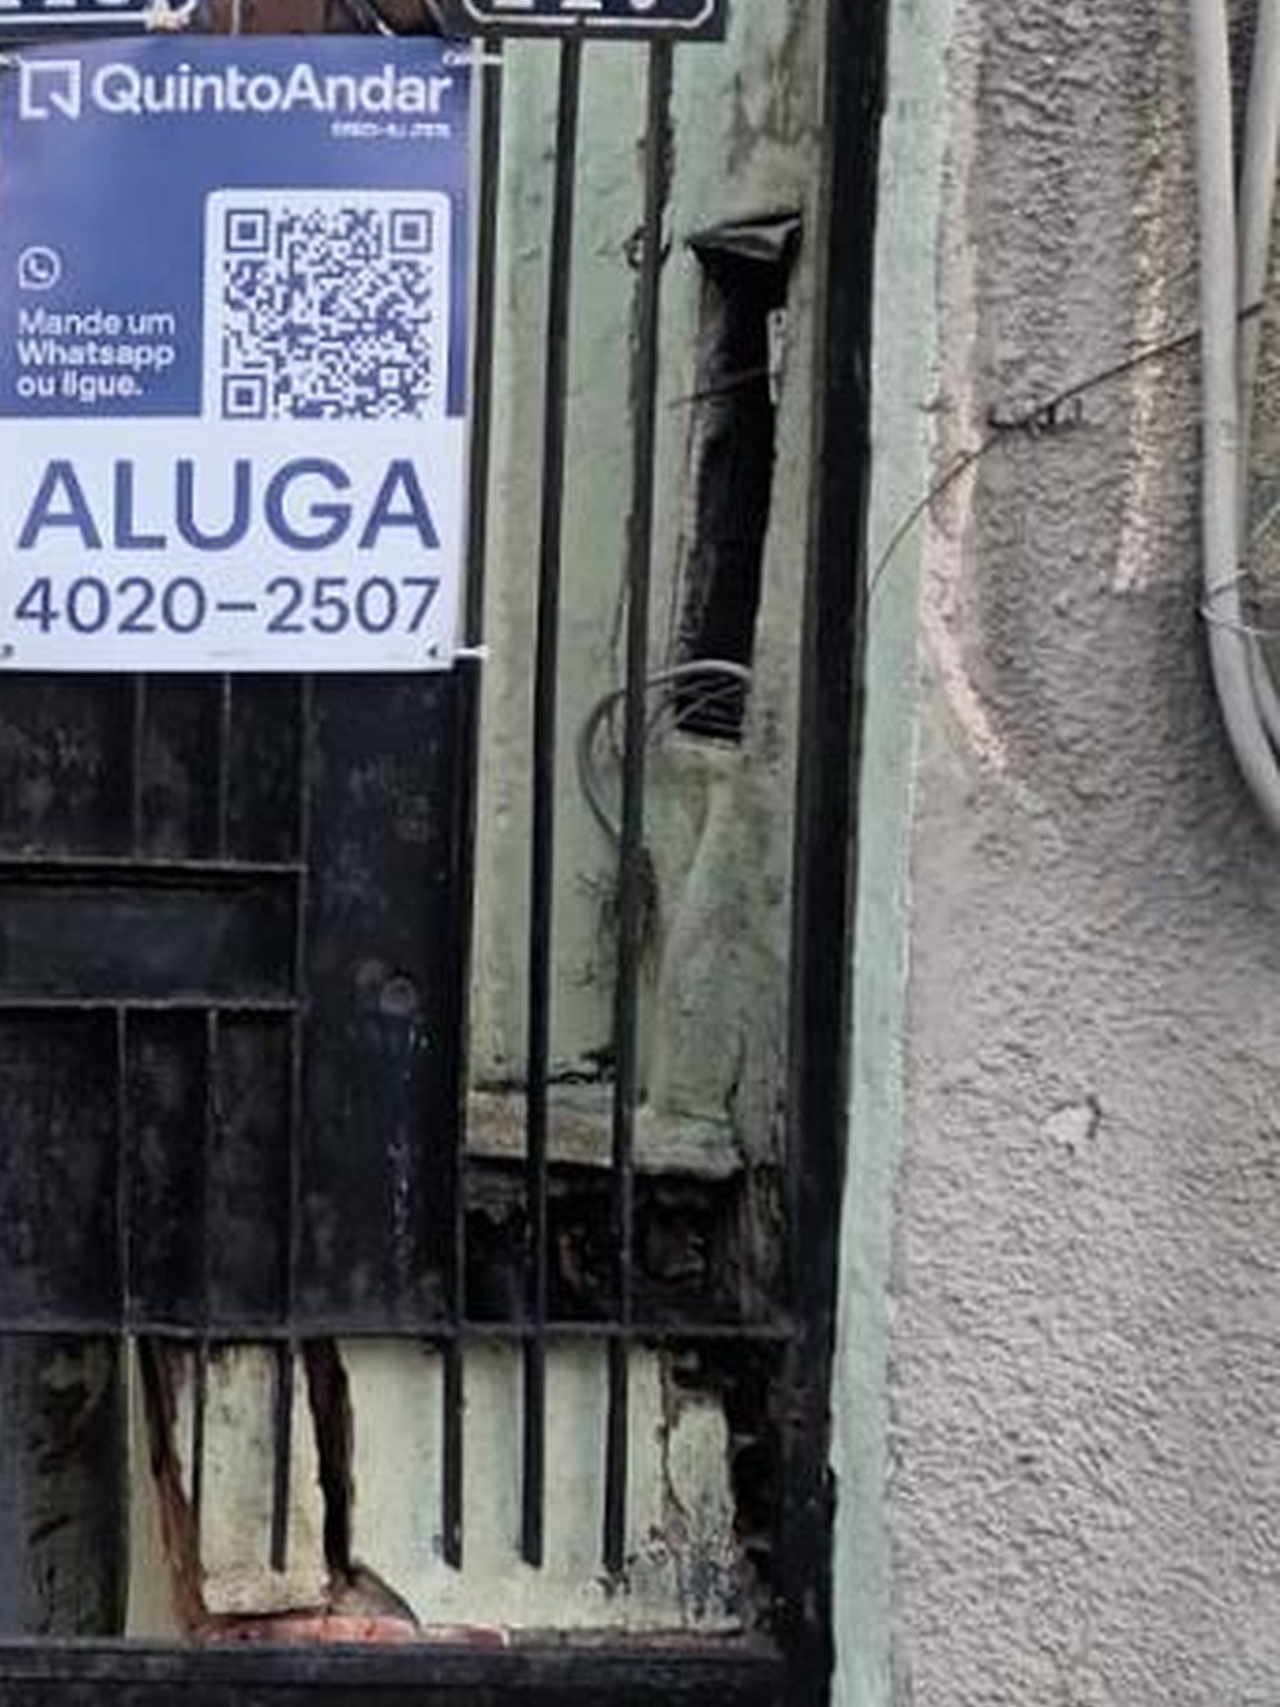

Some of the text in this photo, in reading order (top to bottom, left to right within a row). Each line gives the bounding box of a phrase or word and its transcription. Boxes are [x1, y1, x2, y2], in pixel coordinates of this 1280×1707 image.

[92, 63, 453, 114] QuintoAndar
[18, 308, 176, 335] Mande um
[17, 339, 176, 373] Whatsapp
[17, 369, 143, 403] ou ligue.
[17, 457, 441, 552] ALUGA
[14, 575, 441, 635] 4020-2507
